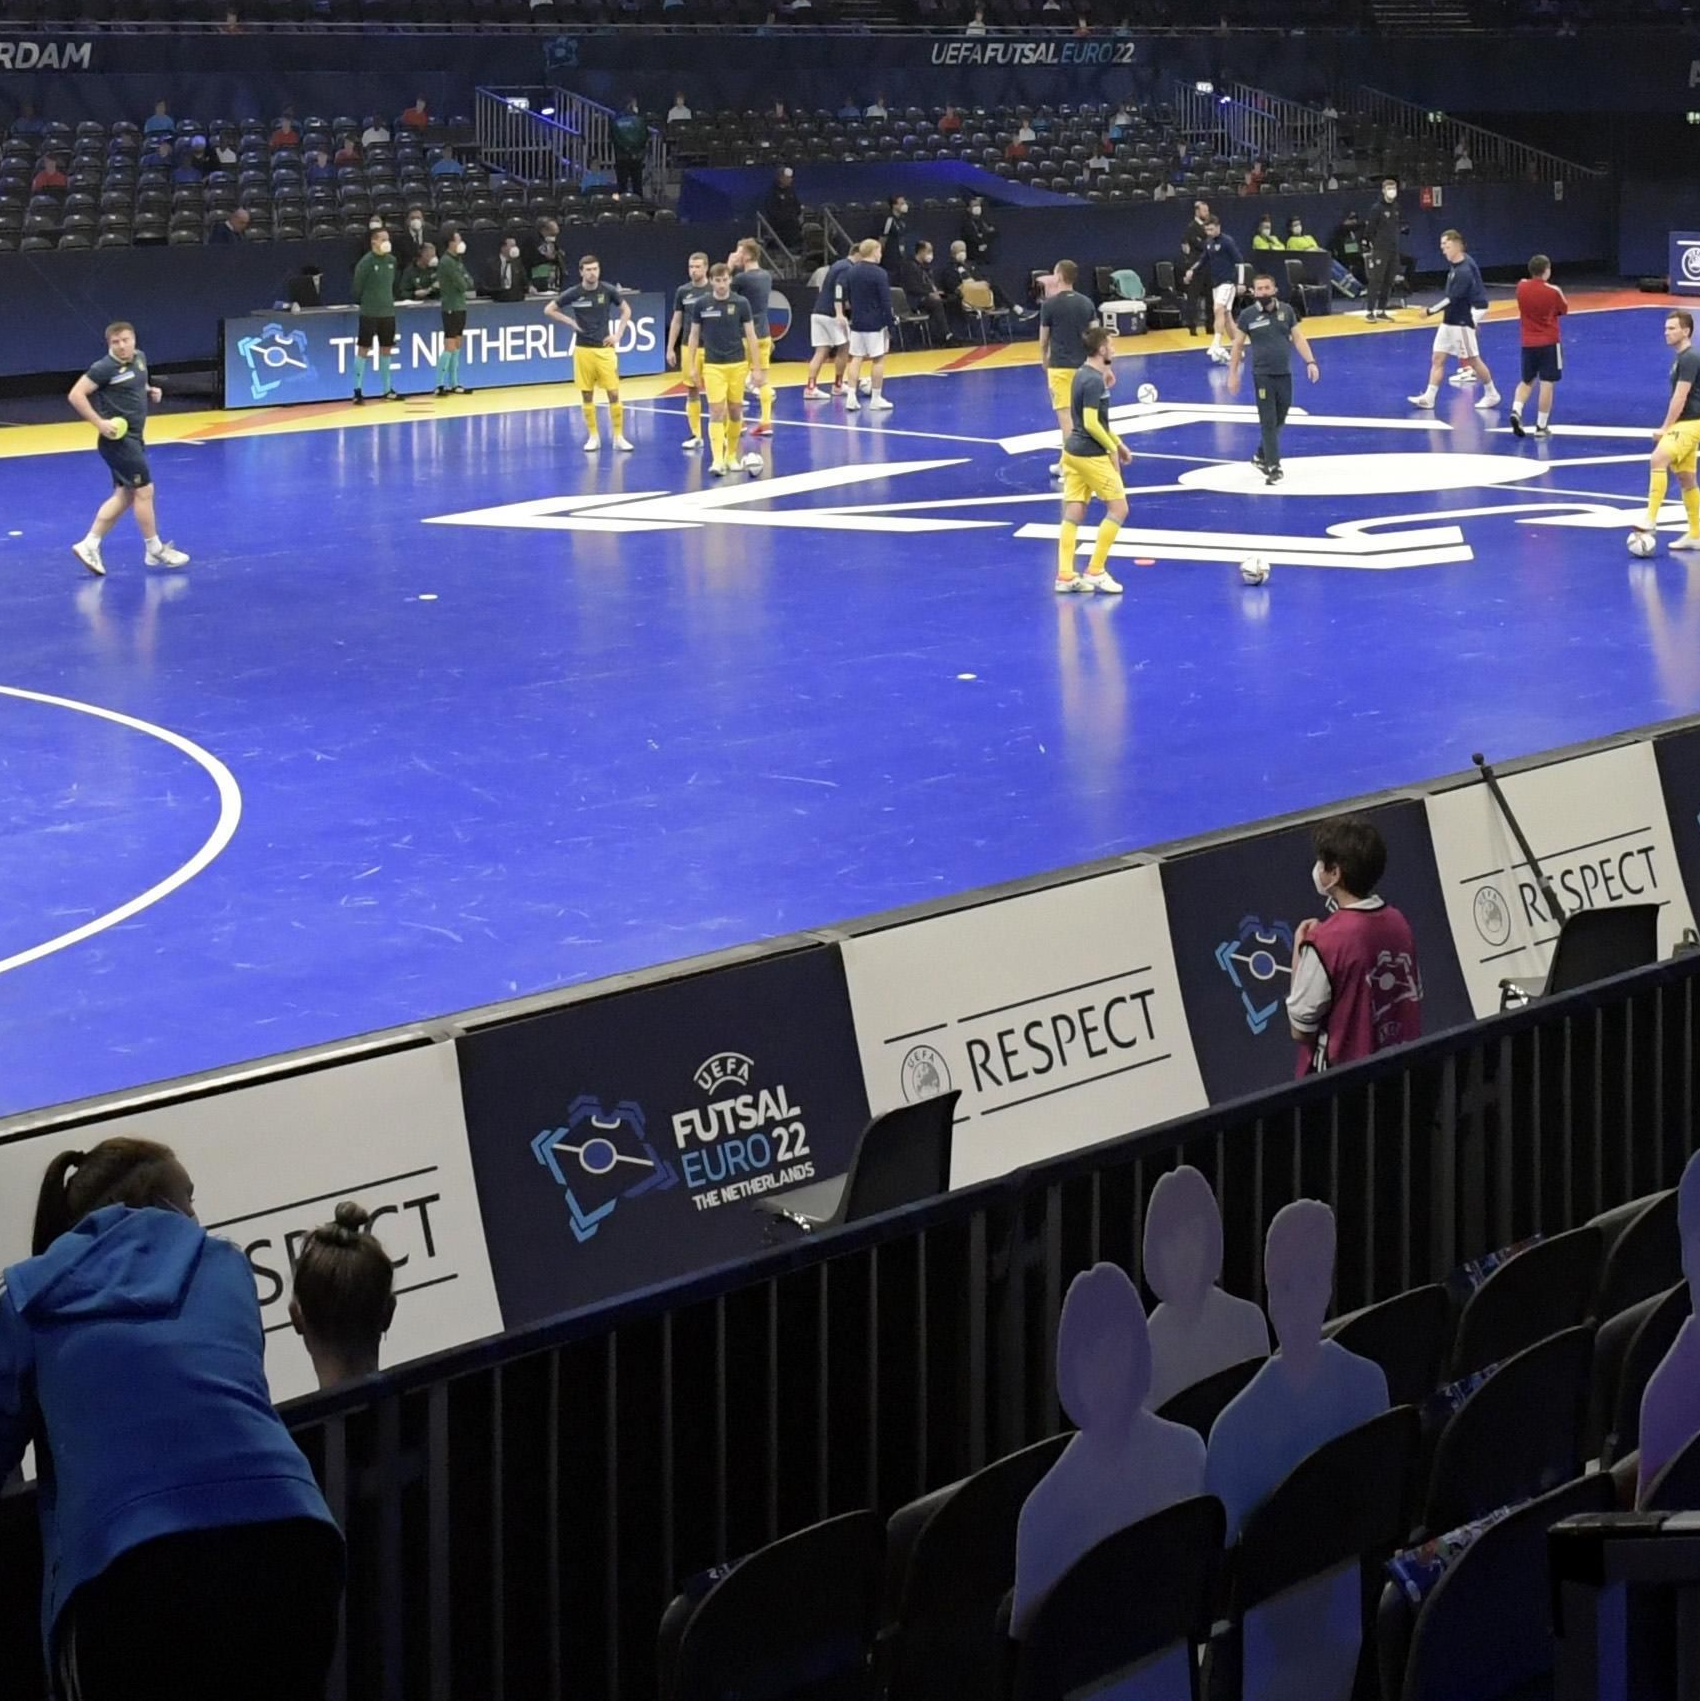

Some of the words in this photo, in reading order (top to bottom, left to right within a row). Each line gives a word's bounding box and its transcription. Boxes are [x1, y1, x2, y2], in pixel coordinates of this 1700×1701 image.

[412, 316, 656, 368] NTHERLDS
[1519, 846, 1657, 927] RSPECT
[966, 988, 1154, 1092] RESPECT
[698, 1058, 749, 1090] UEFA
[672, 1085, 801, 1148] FUTSAL
[682, 1133, 771, 1188] EURO
[772, 1122, 810, 1162] 22
[692, 1190, 721, 1211] THE
[721, 1162, 815, 1203] NETHERLANDS
